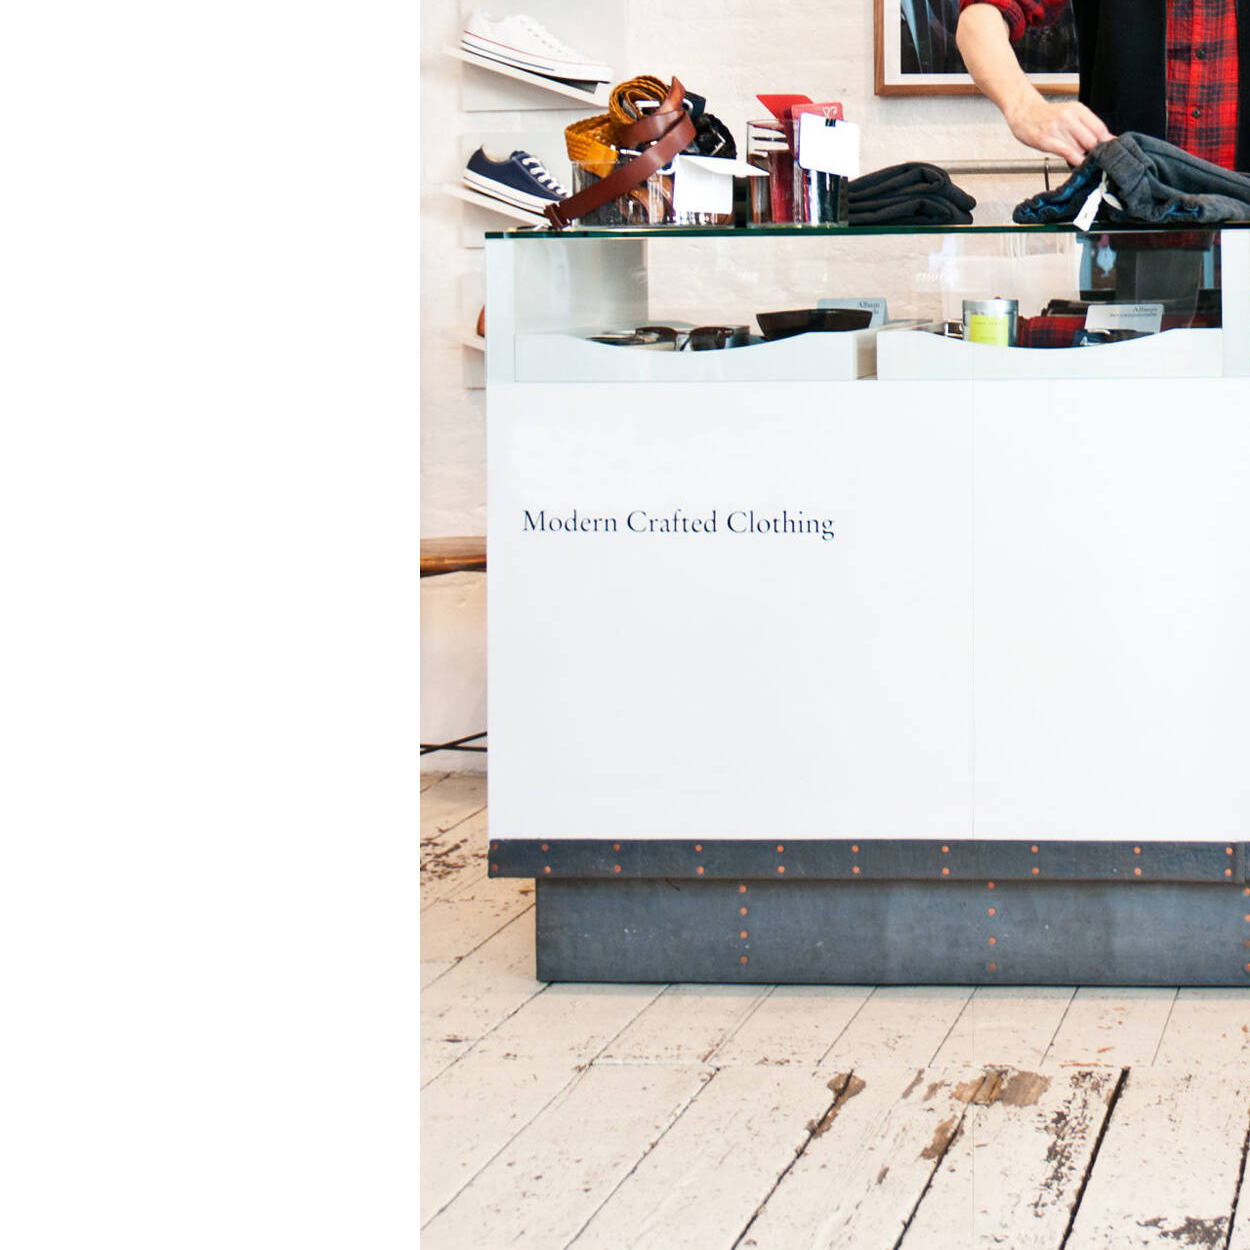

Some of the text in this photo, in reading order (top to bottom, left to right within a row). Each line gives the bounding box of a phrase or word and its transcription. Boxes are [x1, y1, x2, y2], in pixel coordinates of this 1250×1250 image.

[522, 508, 835, 541] Modern Crafted Clothing
